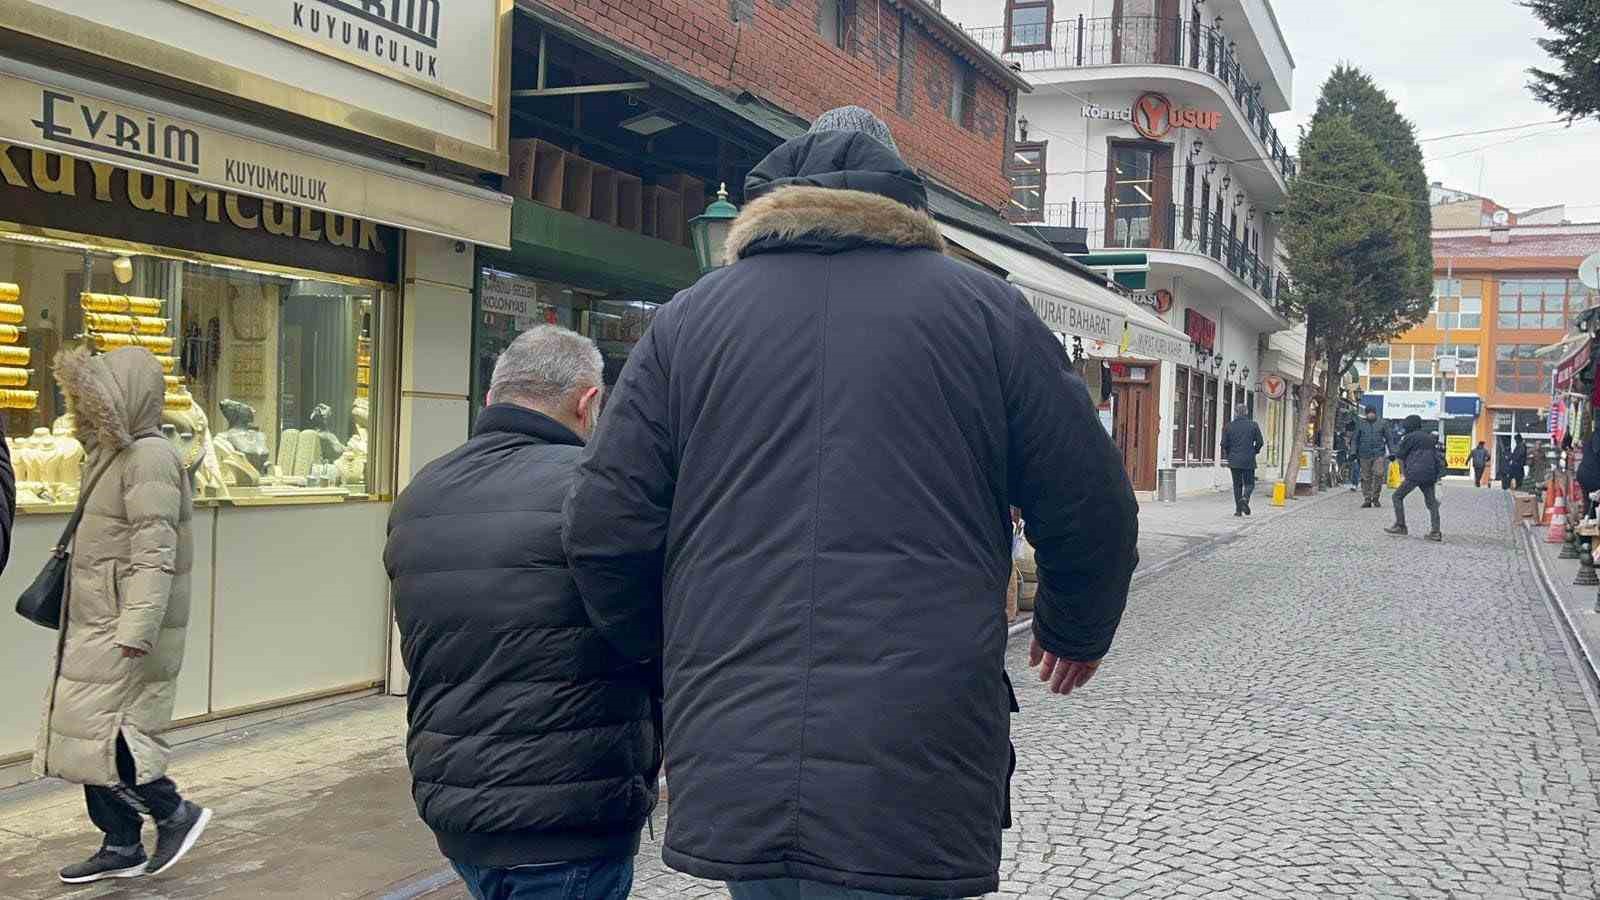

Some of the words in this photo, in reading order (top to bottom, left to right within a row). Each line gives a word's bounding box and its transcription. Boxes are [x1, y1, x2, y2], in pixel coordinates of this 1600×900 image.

[293, 3, 437, 78] KUYUMCULUK
[225, 158, 327, 203] KUYUMCULUK
[1032, 295, 1067, 326] MURAT
[1069, 307, 1112, 337] BAHARAT
